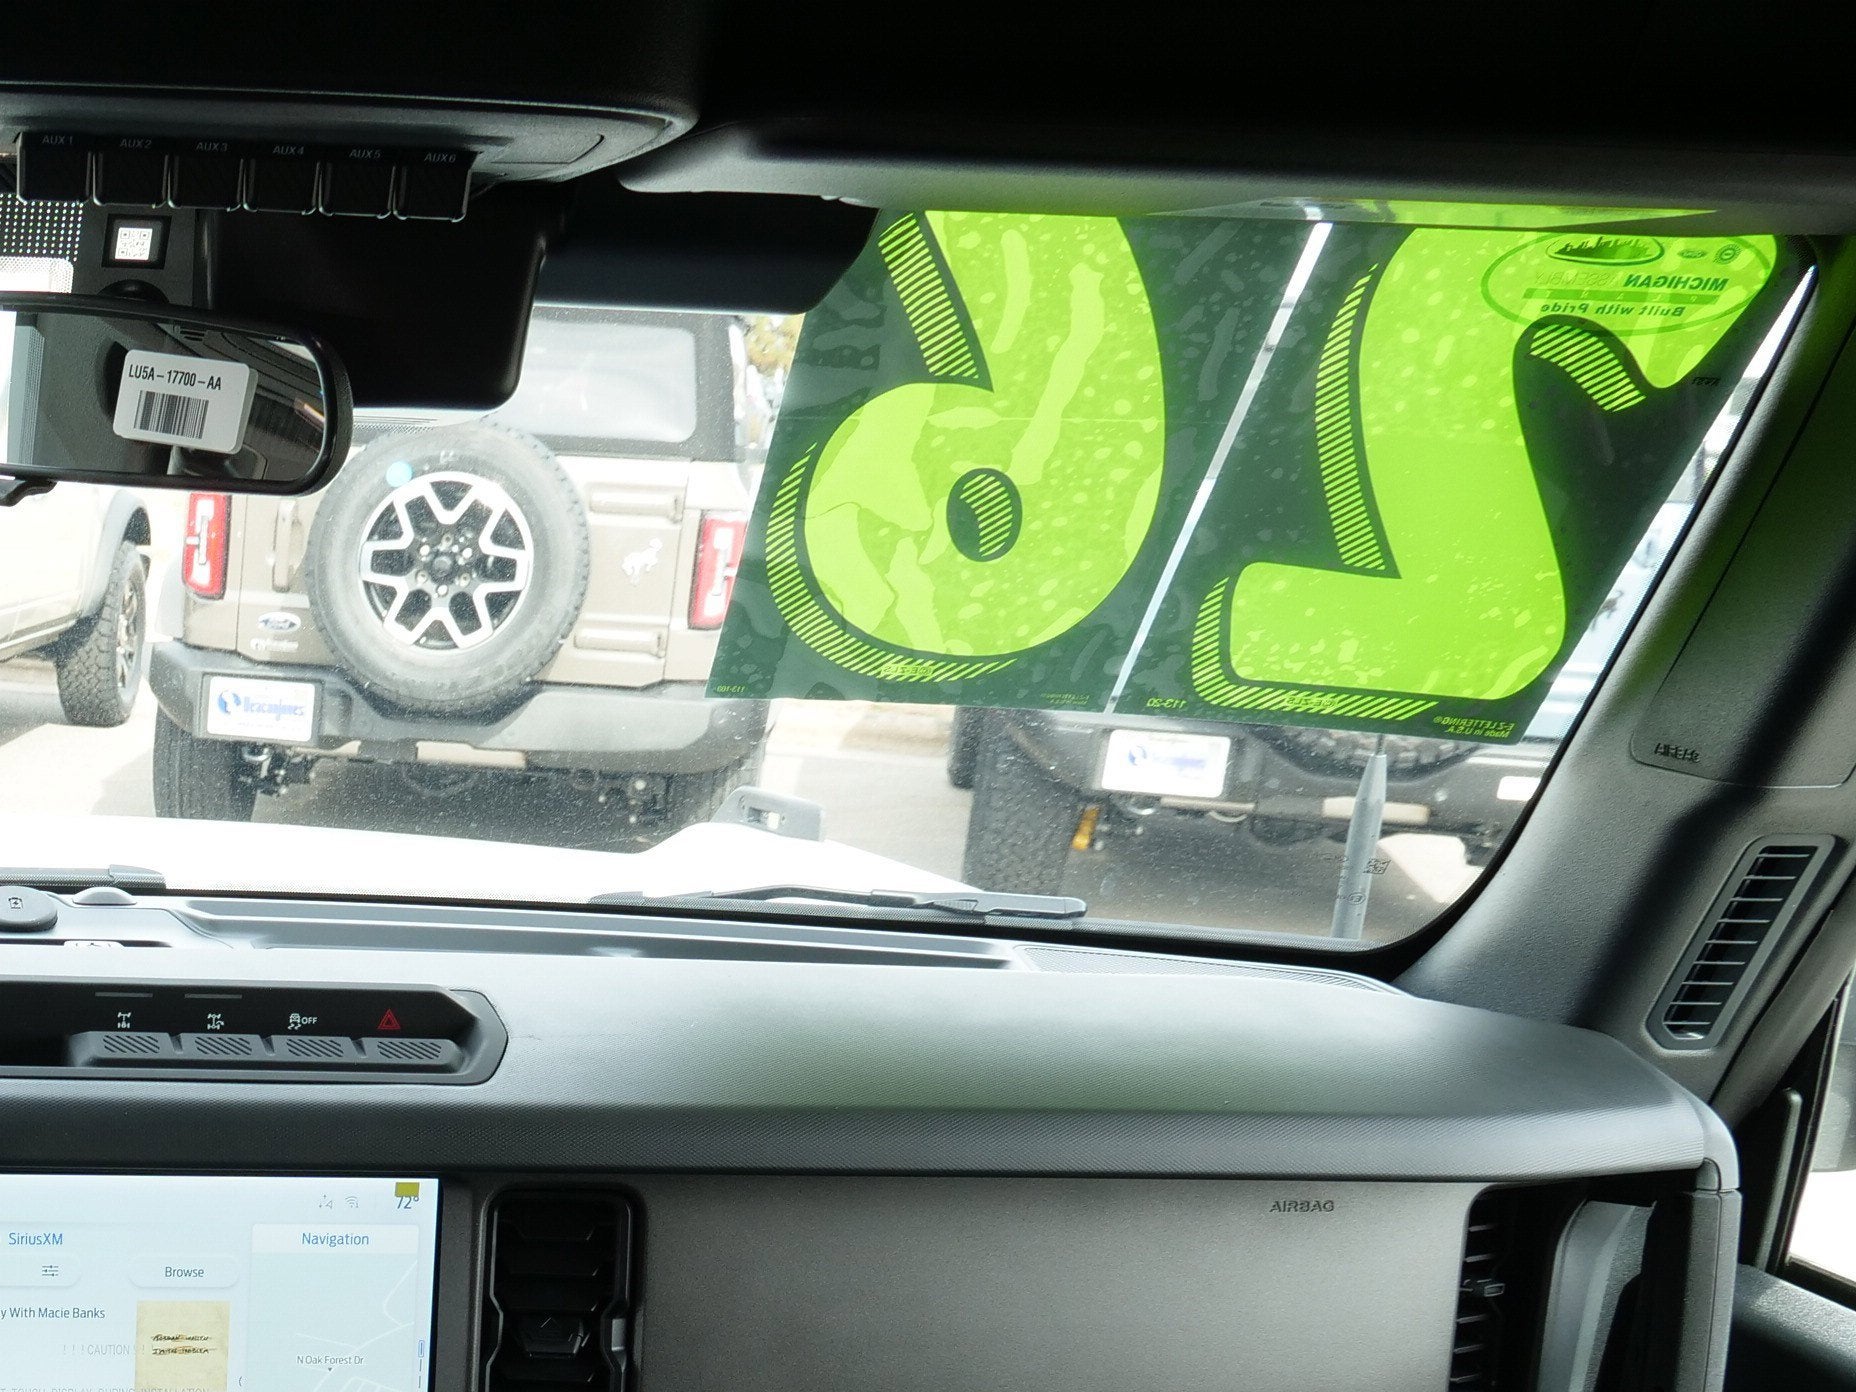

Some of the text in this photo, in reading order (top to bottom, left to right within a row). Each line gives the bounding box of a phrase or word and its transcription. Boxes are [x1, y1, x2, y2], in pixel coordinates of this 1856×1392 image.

[41, 134, 65, 146] AUX
[119, 137, 143, 149] AUX
[195, 141, 219, 152] AUX
[272, 145, 295, 156] AUX
[348, 148, 373, 159] AUX
[423, 152, 447, 163] AUX
[300, 1015, 318, 1025] OFF
[1270, 1199, 1336, 1214] AIRBAG
[8, 1232, 64, 1246] SiriusXM
[301, 1232, 370, 1248] Navigation
[164, 1266, 205, 1278] Browse
[9, 1307, 36, 1319] With
[38, 1307, 70, 1320] Macie
[72, 1307, 106, 1320] Banks
[86, 1344, 130, 1355] CAUTION
[297, 1355, 364, 1365] N Oak Forest Dr
